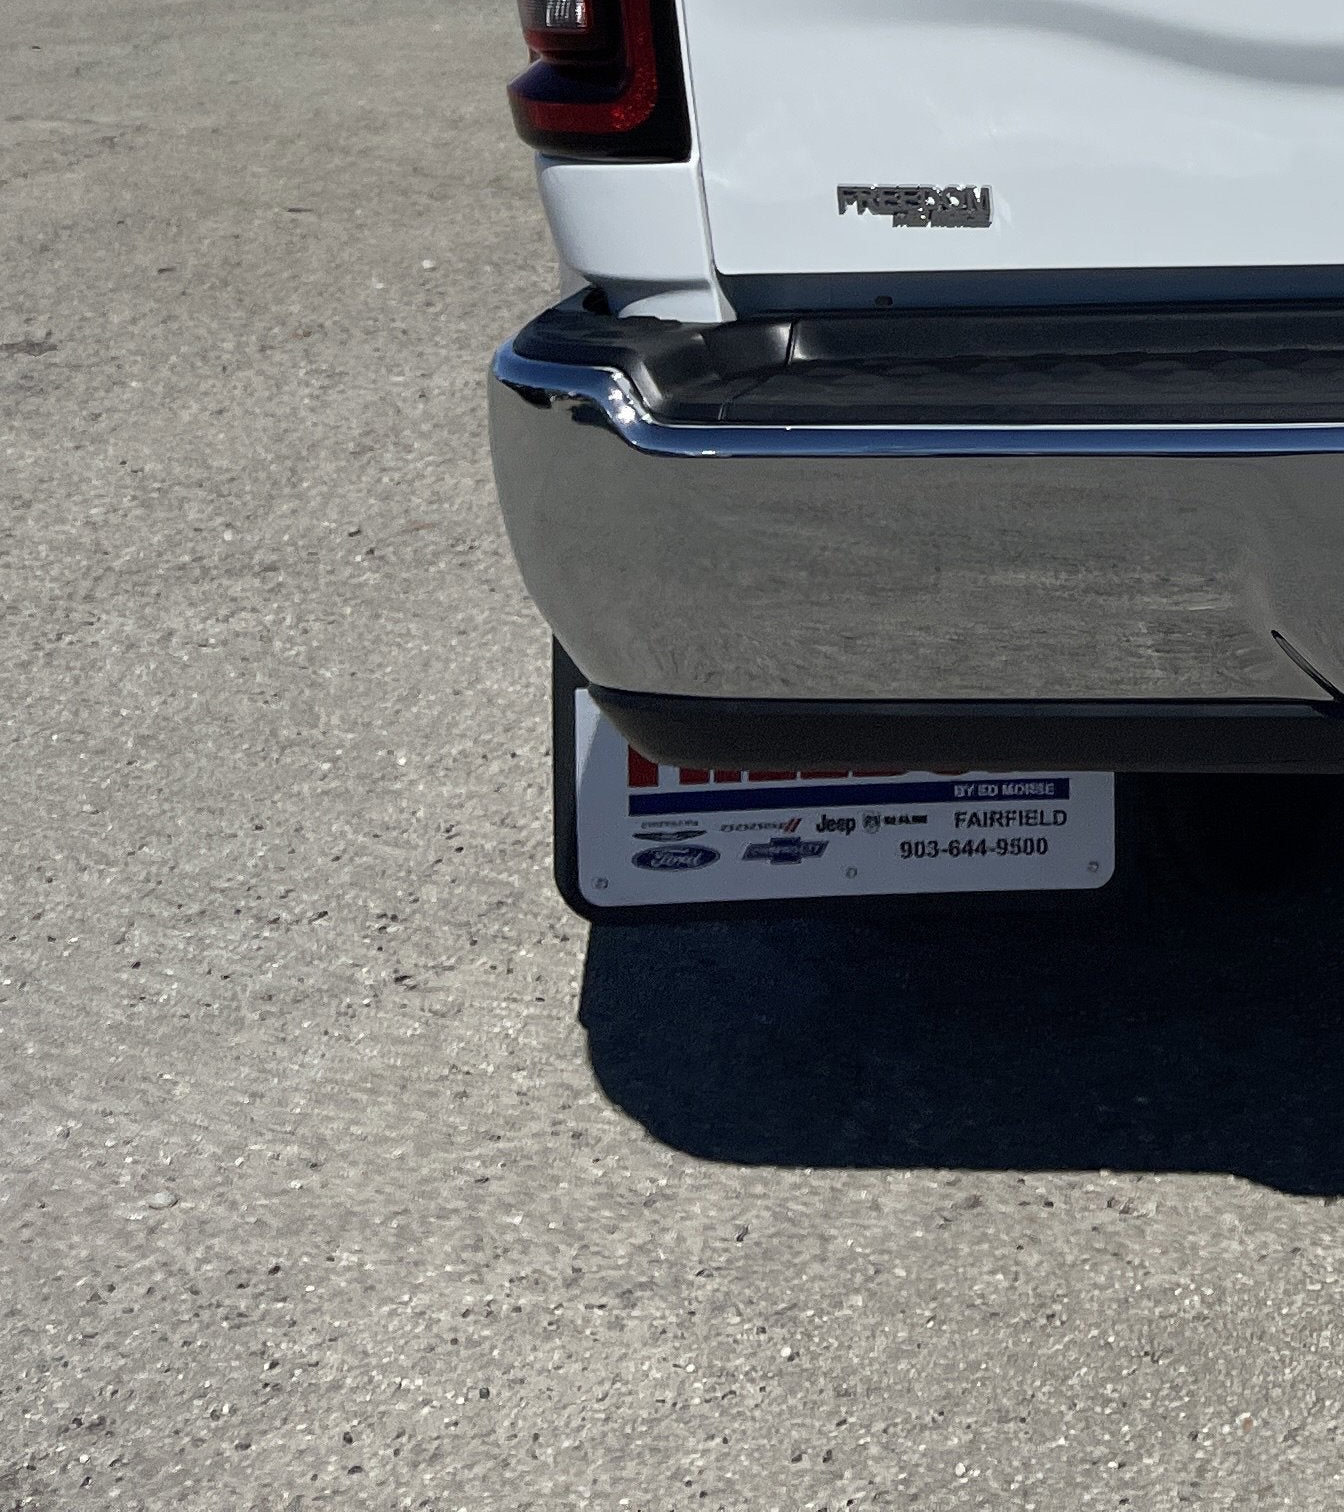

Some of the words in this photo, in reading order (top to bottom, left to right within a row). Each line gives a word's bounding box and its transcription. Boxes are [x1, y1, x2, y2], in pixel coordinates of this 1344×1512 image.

[815, 814, 857, 836] Jeep
[954, 809, 1068, 829] FAIRFIELD
[900, 837, 1049, 859] 903-644-9500
